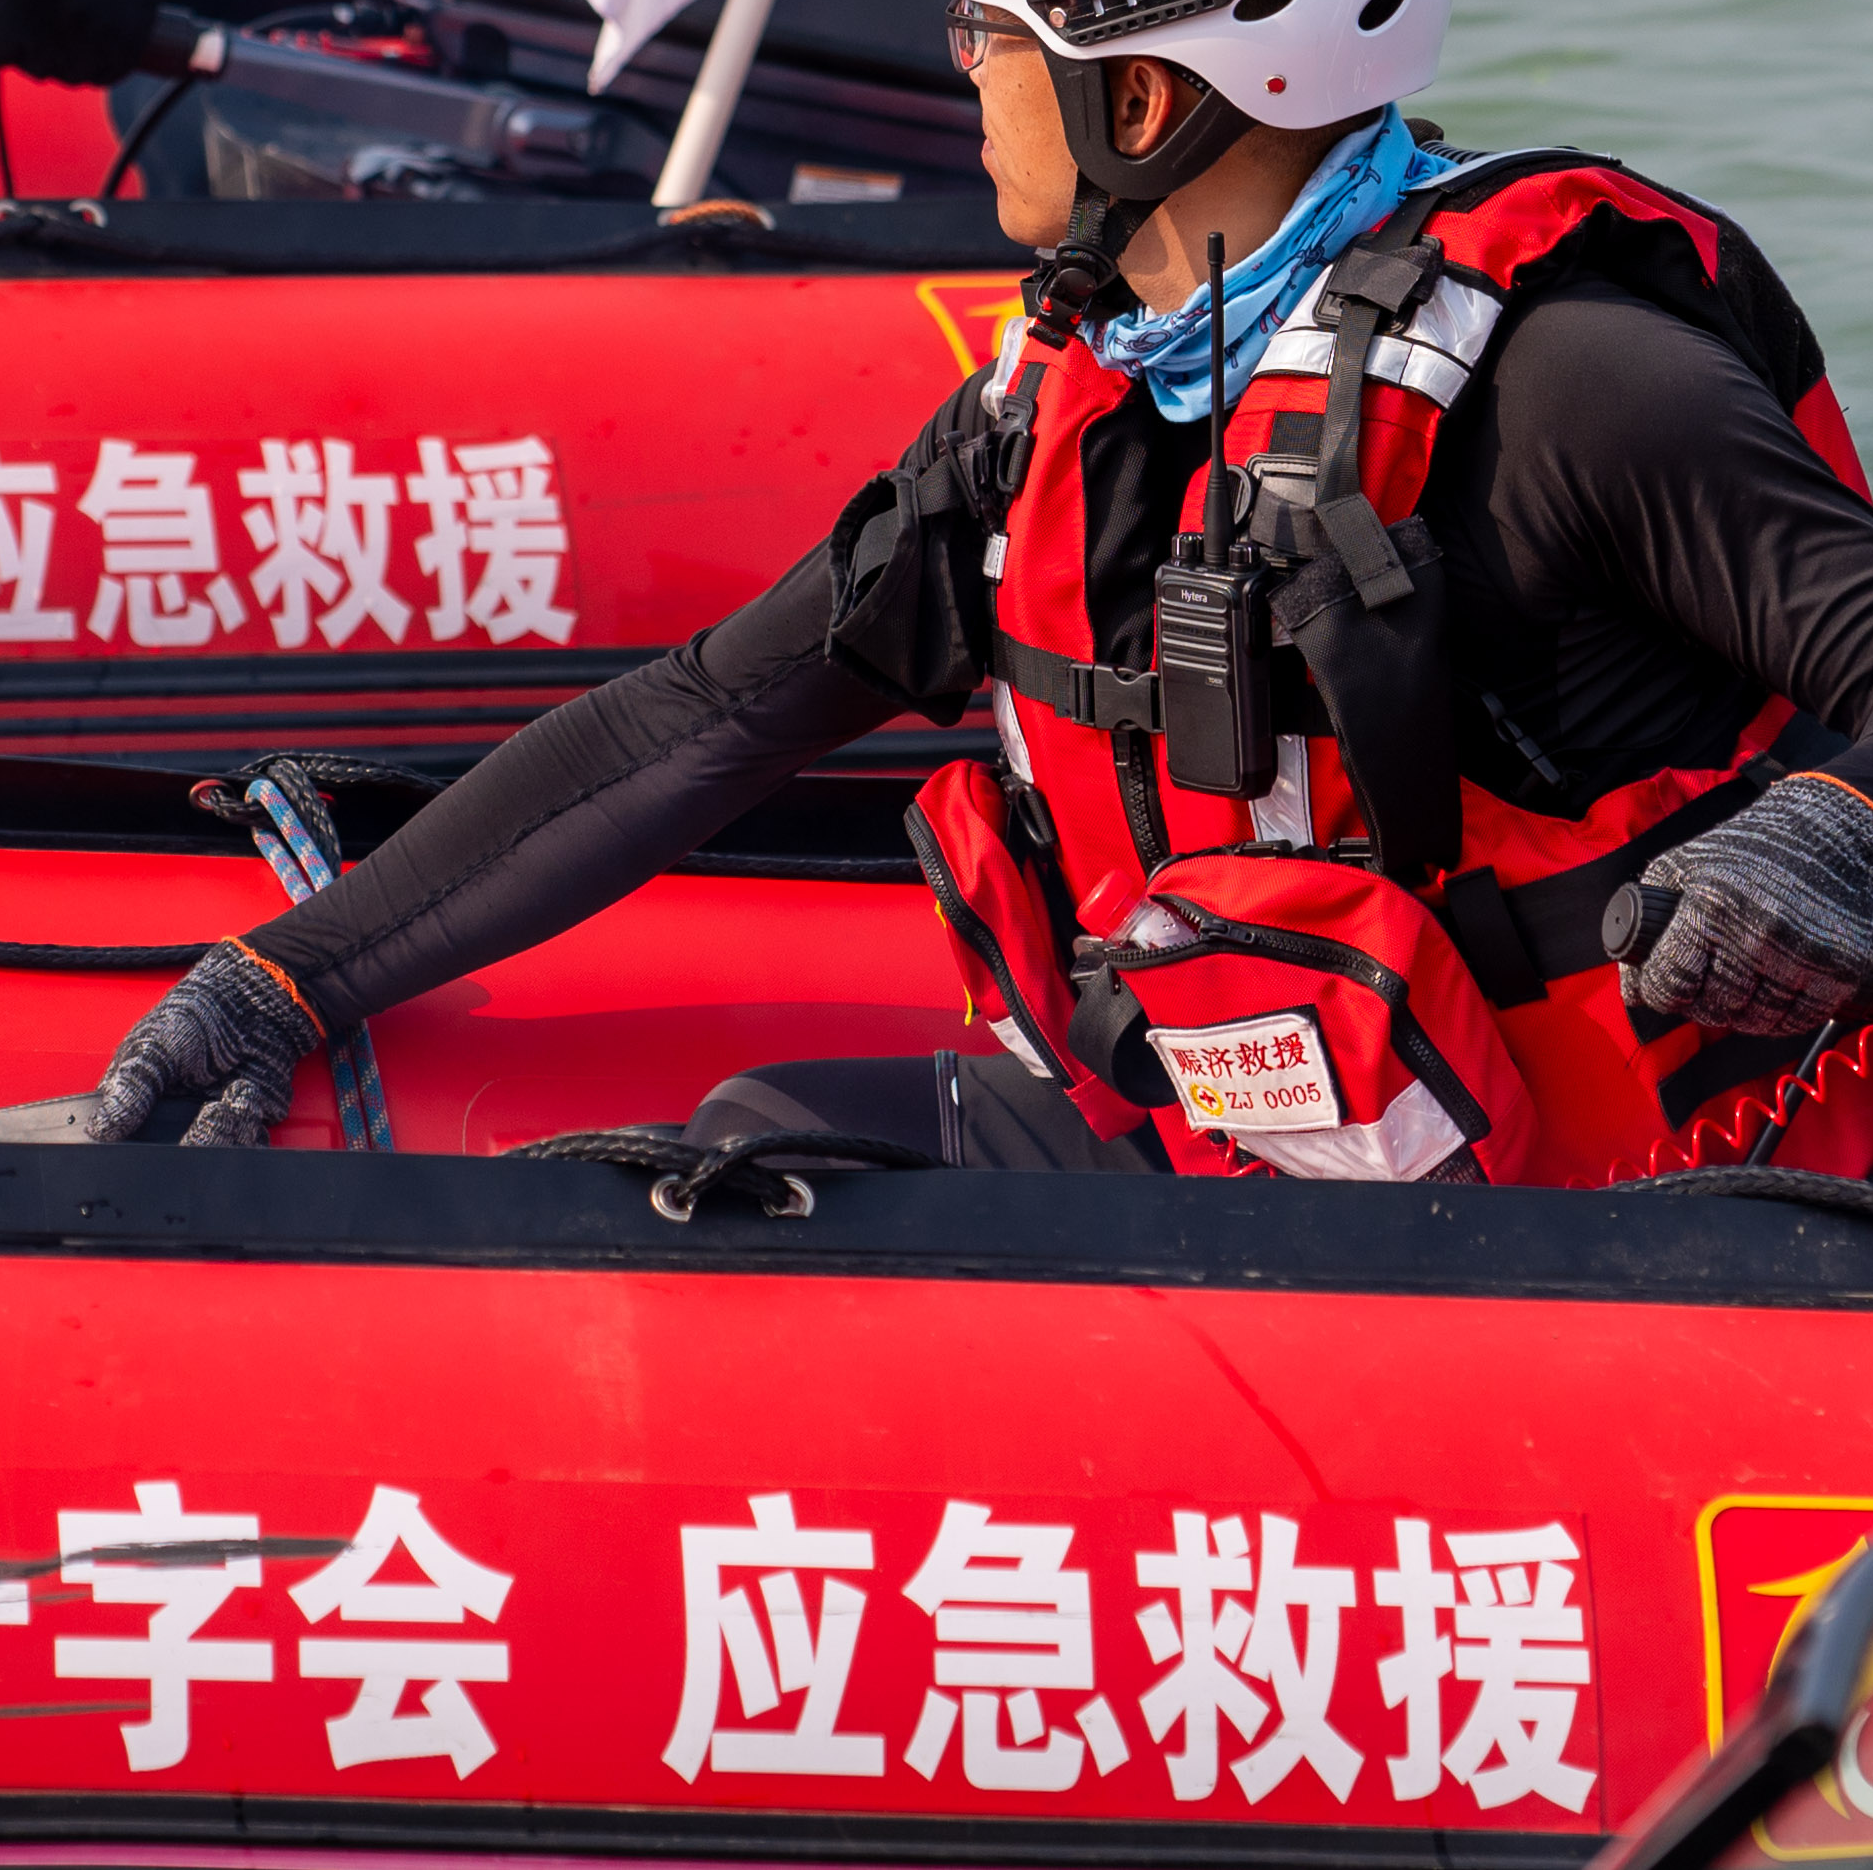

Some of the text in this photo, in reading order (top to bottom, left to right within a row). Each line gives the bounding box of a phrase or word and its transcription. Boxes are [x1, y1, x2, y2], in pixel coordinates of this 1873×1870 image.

[1181, 589, 1208, 604] Hytera
[1170, 1032, 1308, 1079] 赈济救援
[1226, 1082, 1321, 1110] ZJ 0005
[660, 1490, 1599, 1815] 应急救援
